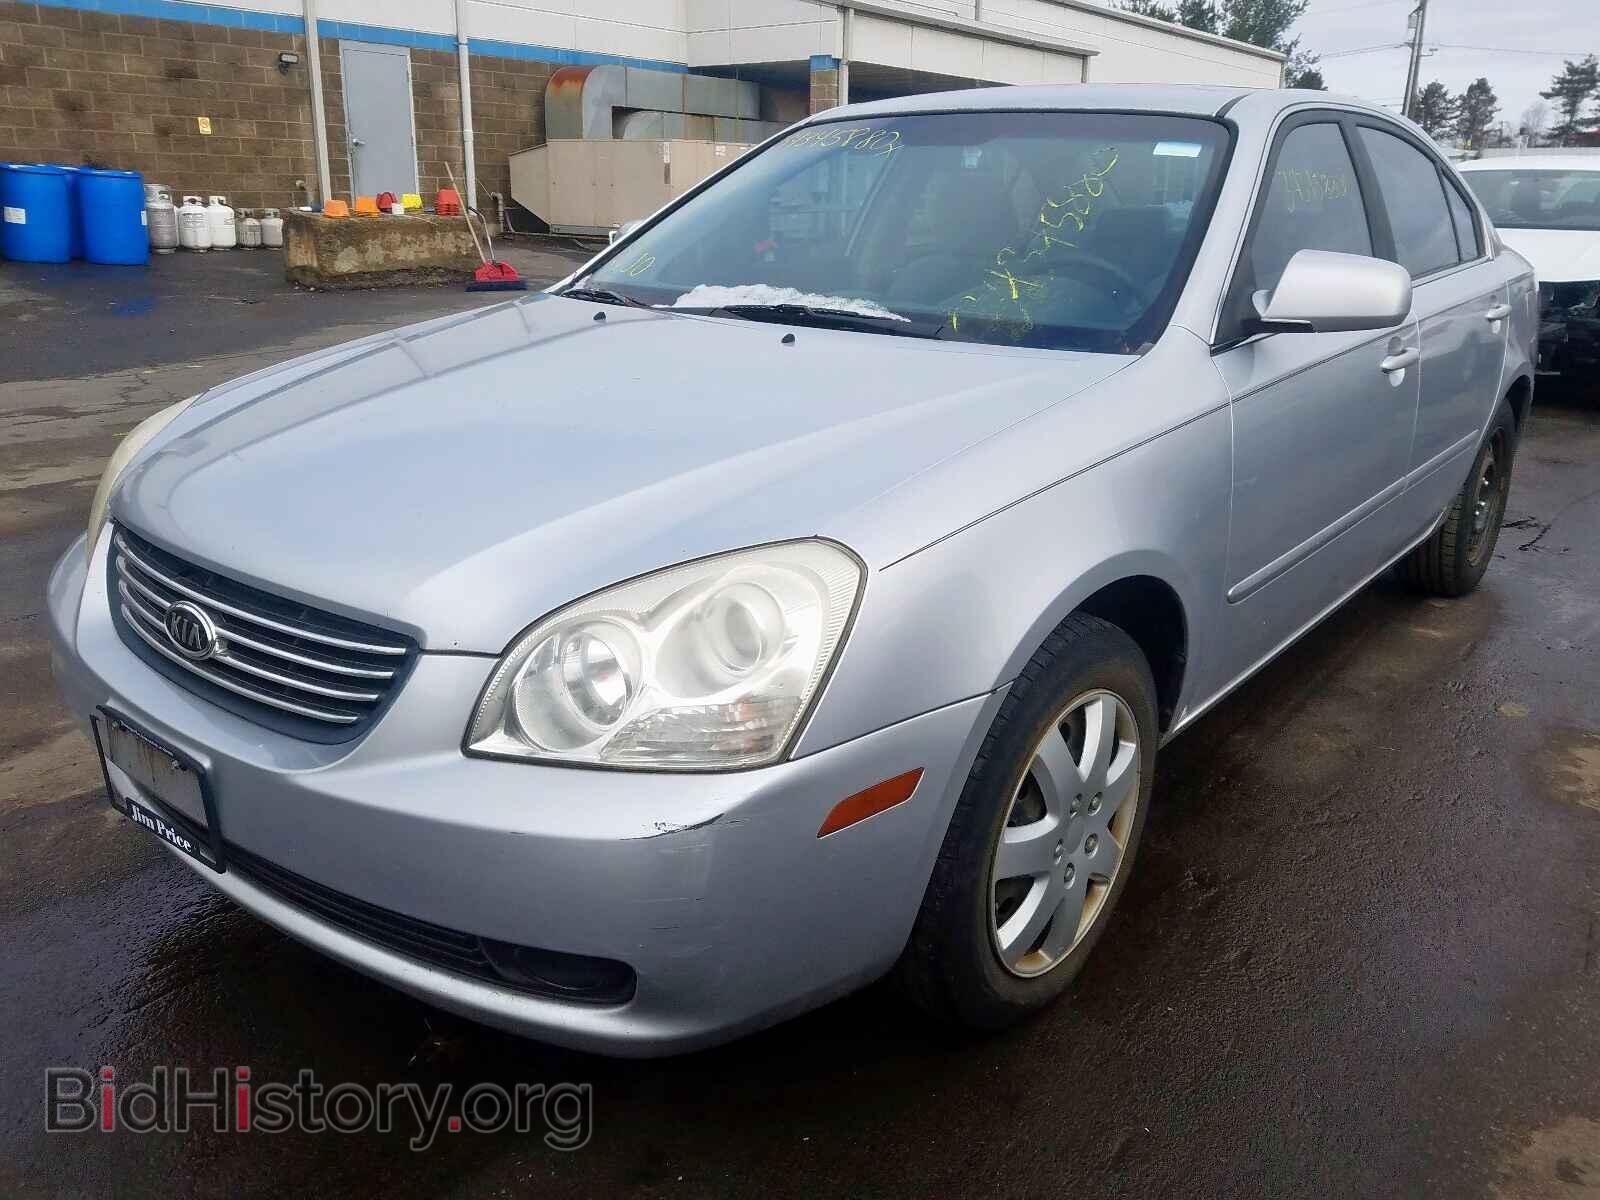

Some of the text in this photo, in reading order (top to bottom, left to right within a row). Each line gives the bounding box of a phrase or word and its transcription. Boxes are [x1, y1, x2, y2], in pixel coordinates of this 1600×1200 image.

[170, 611, 202, 651] KIA
[131, 803, 192, 853] Jim Price
